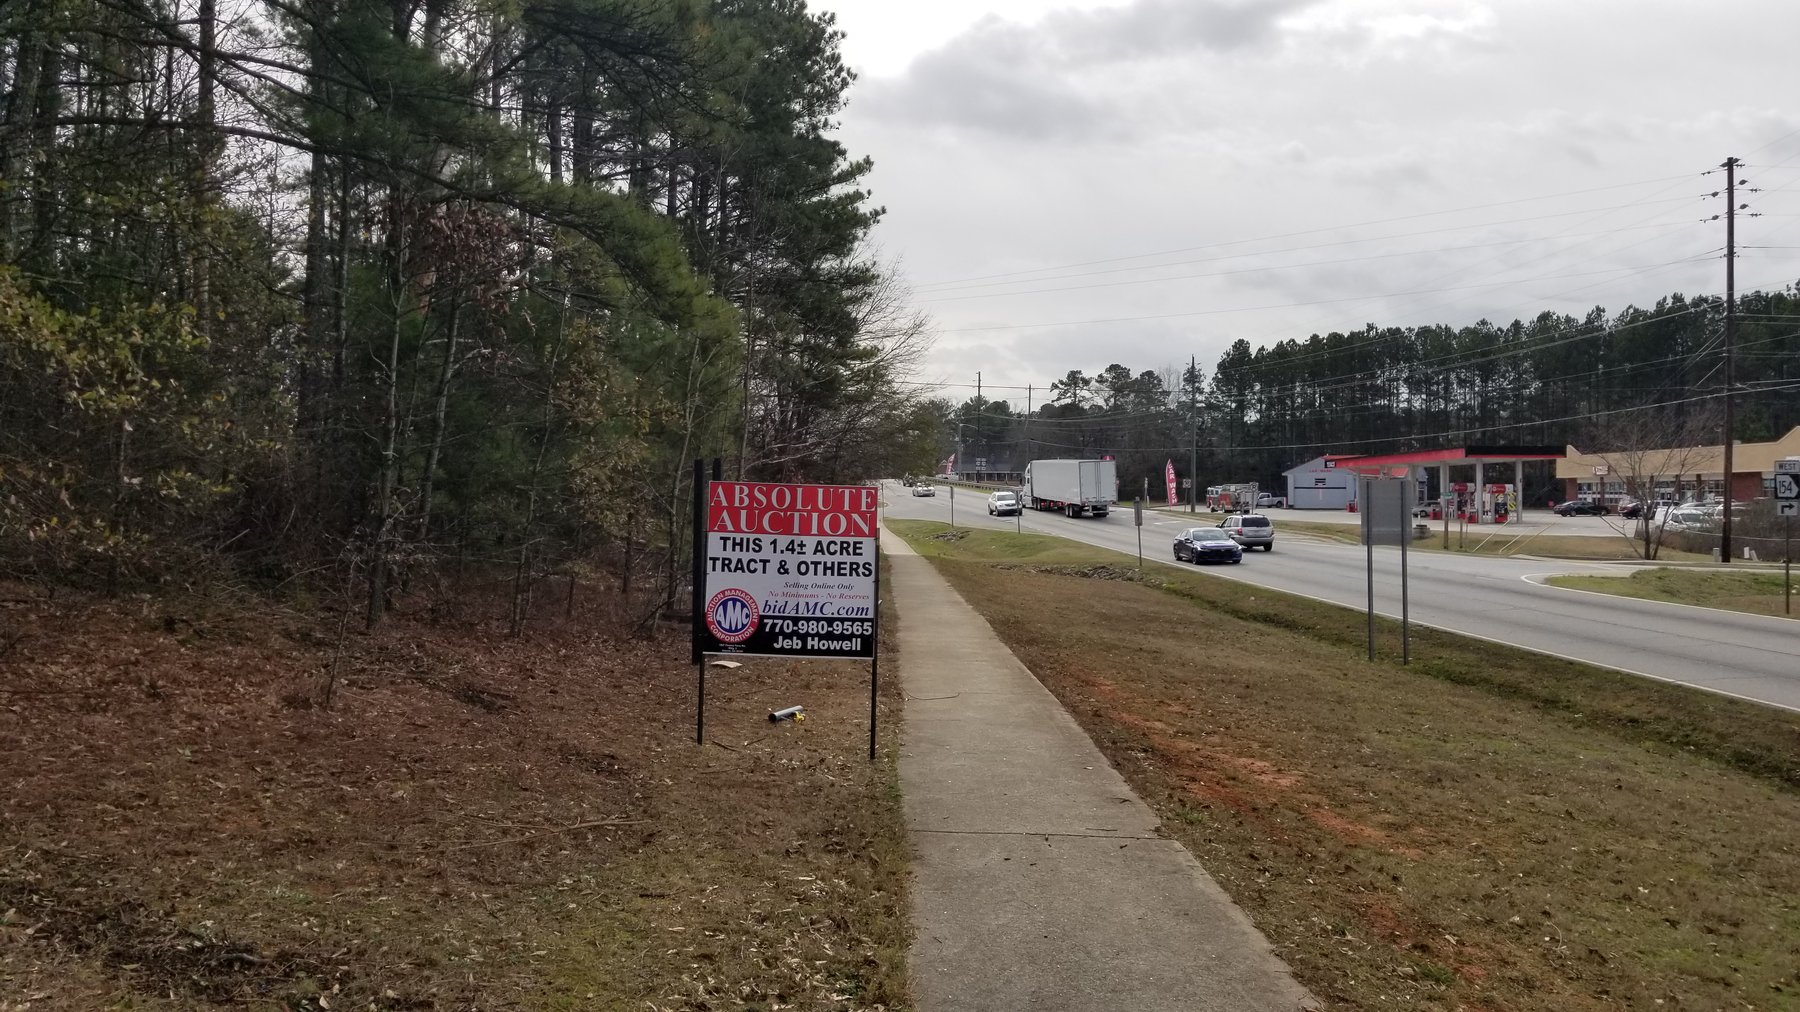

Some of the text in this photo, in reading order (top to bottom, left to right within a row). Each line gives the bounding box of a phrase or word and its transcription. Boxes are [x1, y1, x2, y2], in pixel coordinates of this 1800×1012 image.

[1778, 463, 1796, 471] WEST
[1169, 482, 1178, 504] WASH
[1778, 480, 1792, 494] 154
[711, 484, 877, 512] ABSOLUTE
[714, 509, 872, 536] AUCTION
[719, 536, 864, 556] THIS 1.4± ACRE
[709, 556, 873, 577] TRACT & OTHERS
[781, 591, 819, 599] Minimums
[783, 581, 855, 591] Selling Online Only
[707, 589, 758, 622] AUCTION MANAGEMENT
[762, 599, 870, 616] bidAMC.com
[716, 600, 750, 630] AMC
[710, 624, 754, 642] CORPORATION
[763, 618, 873, 635] 770-980-9565
[773, 635, 861, 651] Jeb Howell
